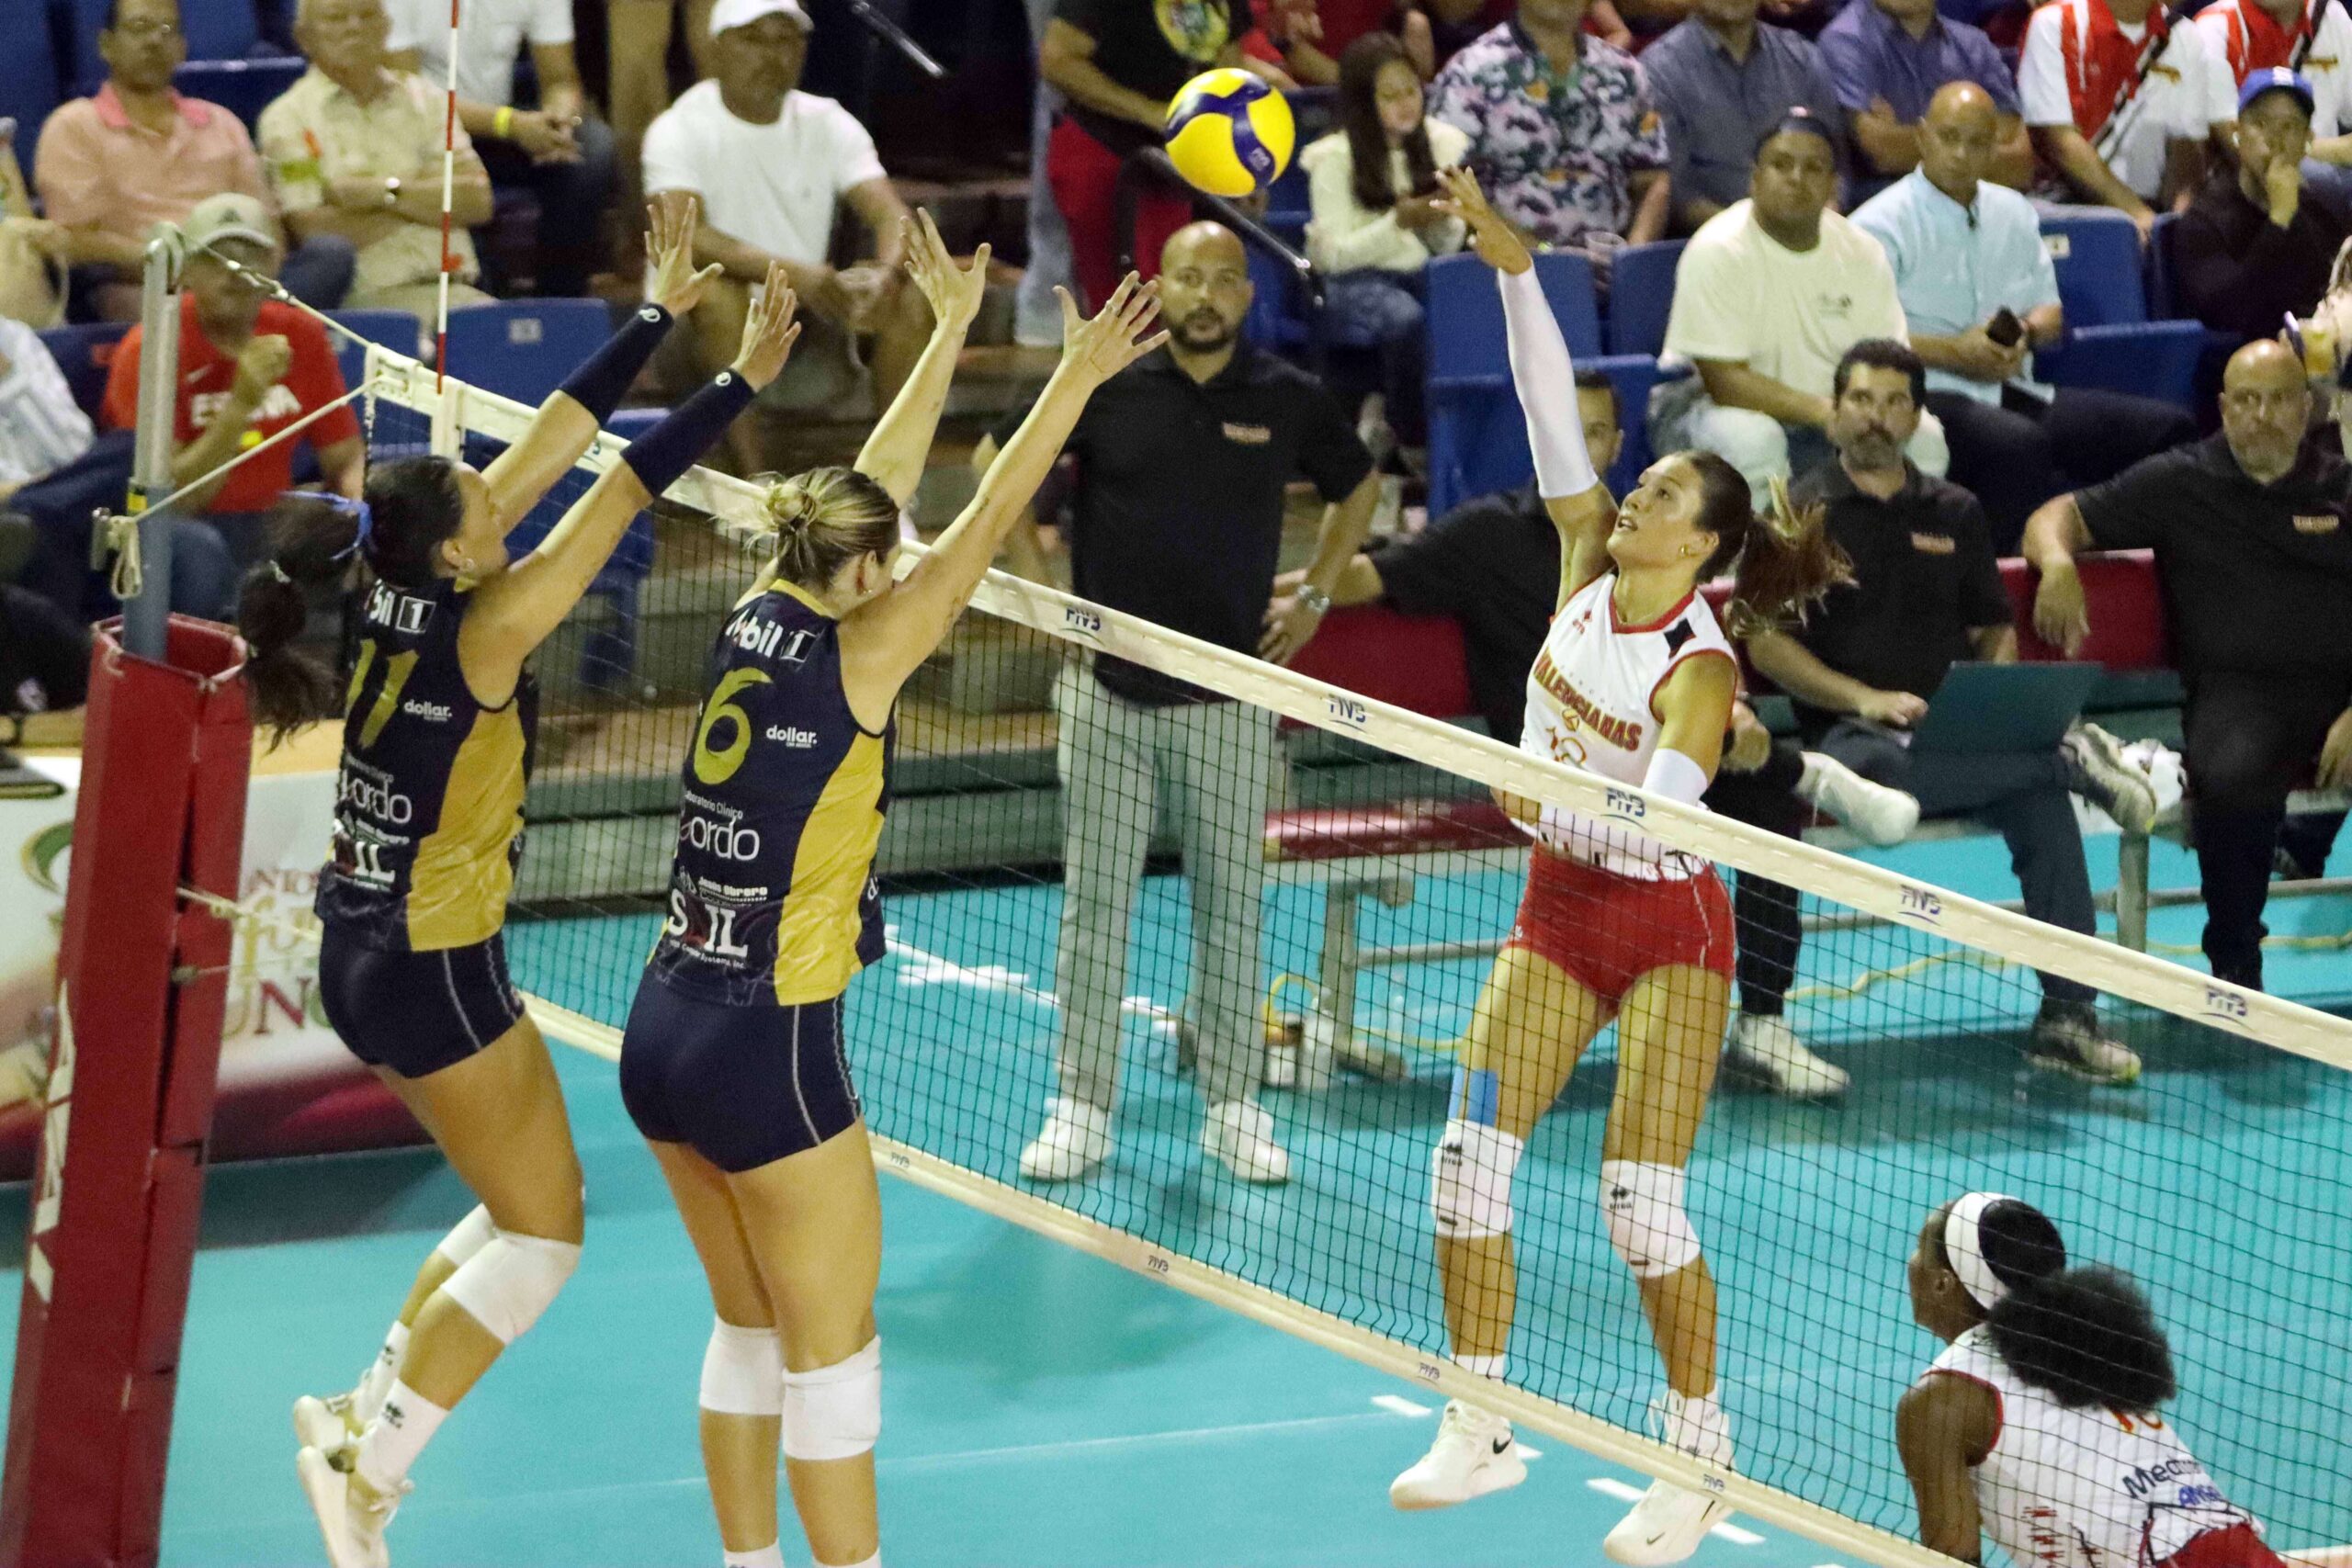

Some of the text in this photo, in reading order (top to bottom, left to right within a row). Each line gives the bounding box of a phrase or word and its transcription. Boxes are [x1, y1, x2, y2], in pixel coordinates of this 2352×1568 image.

[345, 637, 421, 750] 11
[694, 666, 774, 785] 6
[765, 724, 818, 744] dollar.
